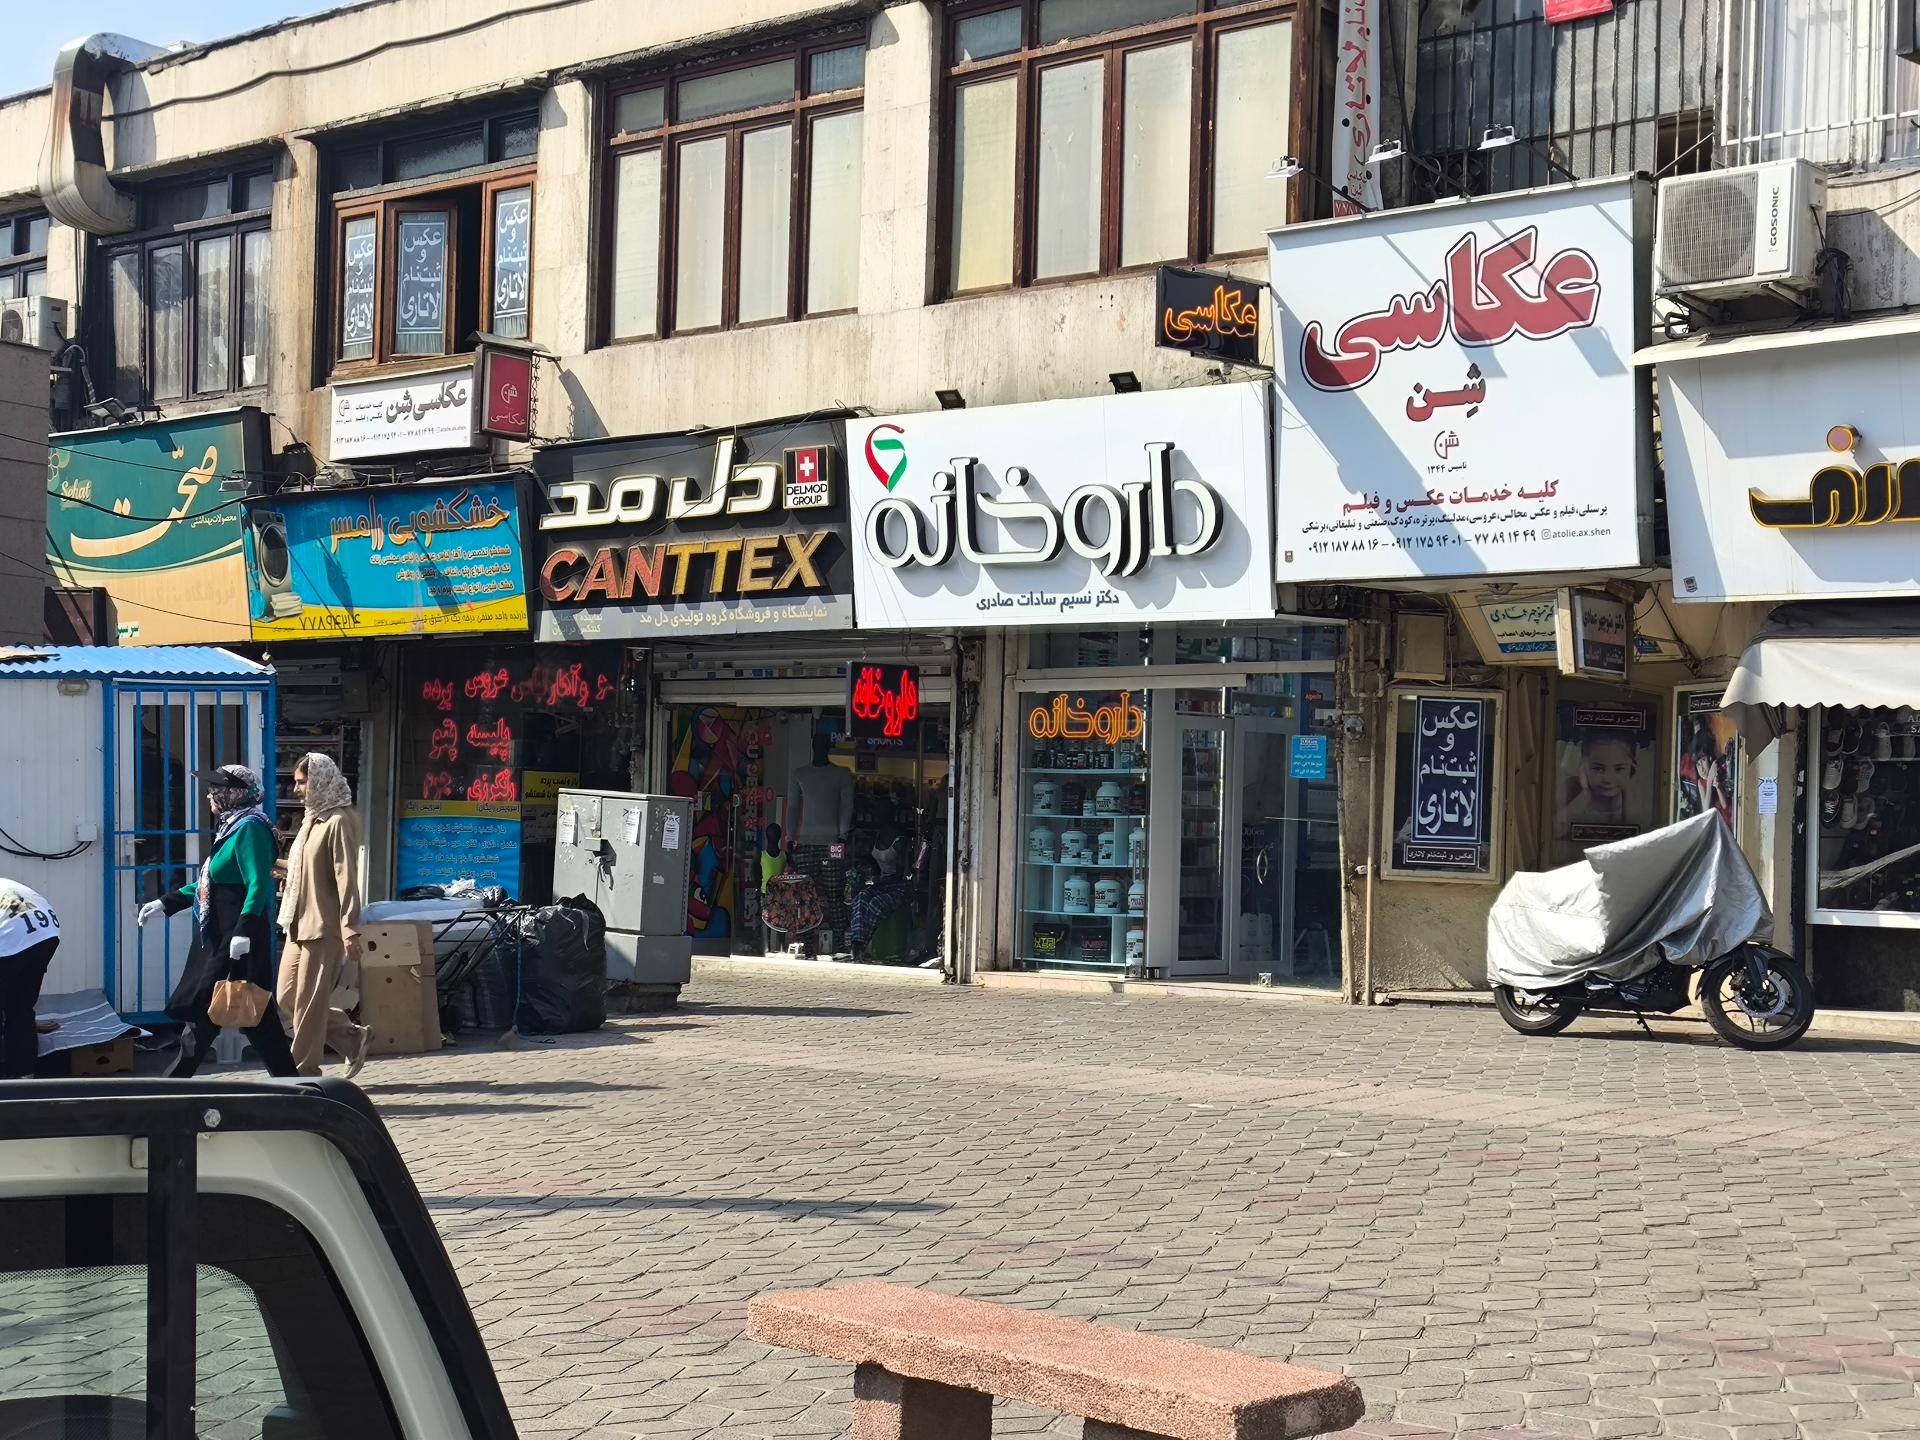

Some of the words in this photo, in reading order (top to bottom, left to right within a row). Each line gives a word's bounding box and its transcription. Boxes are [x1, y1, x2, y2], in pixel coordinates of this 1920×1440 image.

[1768, 186, 1780, 247] GOSONIC
[404, 227, 442, 252] عکس
[416, 248, 427, 263] و
[401, 290, 440, 326] لاتاری
[1164, 286, 1257, 341] عکاسی
[1301, 223, 1601, 392] عکاسی
[412, 379, 468, 421] عکاسی
[490, 409, 526, 425] عکاسی
[667, 434, 782, 520] دل
[786, 483, 827, 496] DELMOD
[1449, 484, 1512, 504] خدمات
[1517, 479, 1560, 503] کلیه
[539, 474, 665, 531] مد
[792, 495, 823, 506] GROUP
[865, 440, 1226, 578] داروخانه
[1343, 490, 1380, 516] فیلم
[1384, 499, 1392, 514] و
[1396, 487, 1445, 515] عکس
[1552, 527, 1612, 539] atolie.ax.shen
[540, 530, 832, 601] CANTTEX
[976, 593, 1015, 612] صادری
[1017, 591, 1056, 609] سادات
[1057, 593, 1085, 610] نسیم
[1086, 590, 1120, 607] دکتر
[639, 615, 653, 624] مد
[654, 613, 669, 626] دل
[670, 612, 703, 627] تولیدی
[705, 609, 727, 624] گروه
[729, 606, 771, 622] فروشگاه
[773, 611, 780, 622] و
[781, 604, 828, 622] نمایشگاه
[1545, 604, 1556, 623] کتر
[852, 667, 918, 737] داروخانه
[1029, 692, 1143, 745] داروخانه
[1421, 706, 1479, 736] عکس
[1438, 732, 1455, 751] و
[1418, 788, 1477, 834] لاتاری
[1454, 852, 1474, 861] عکس
